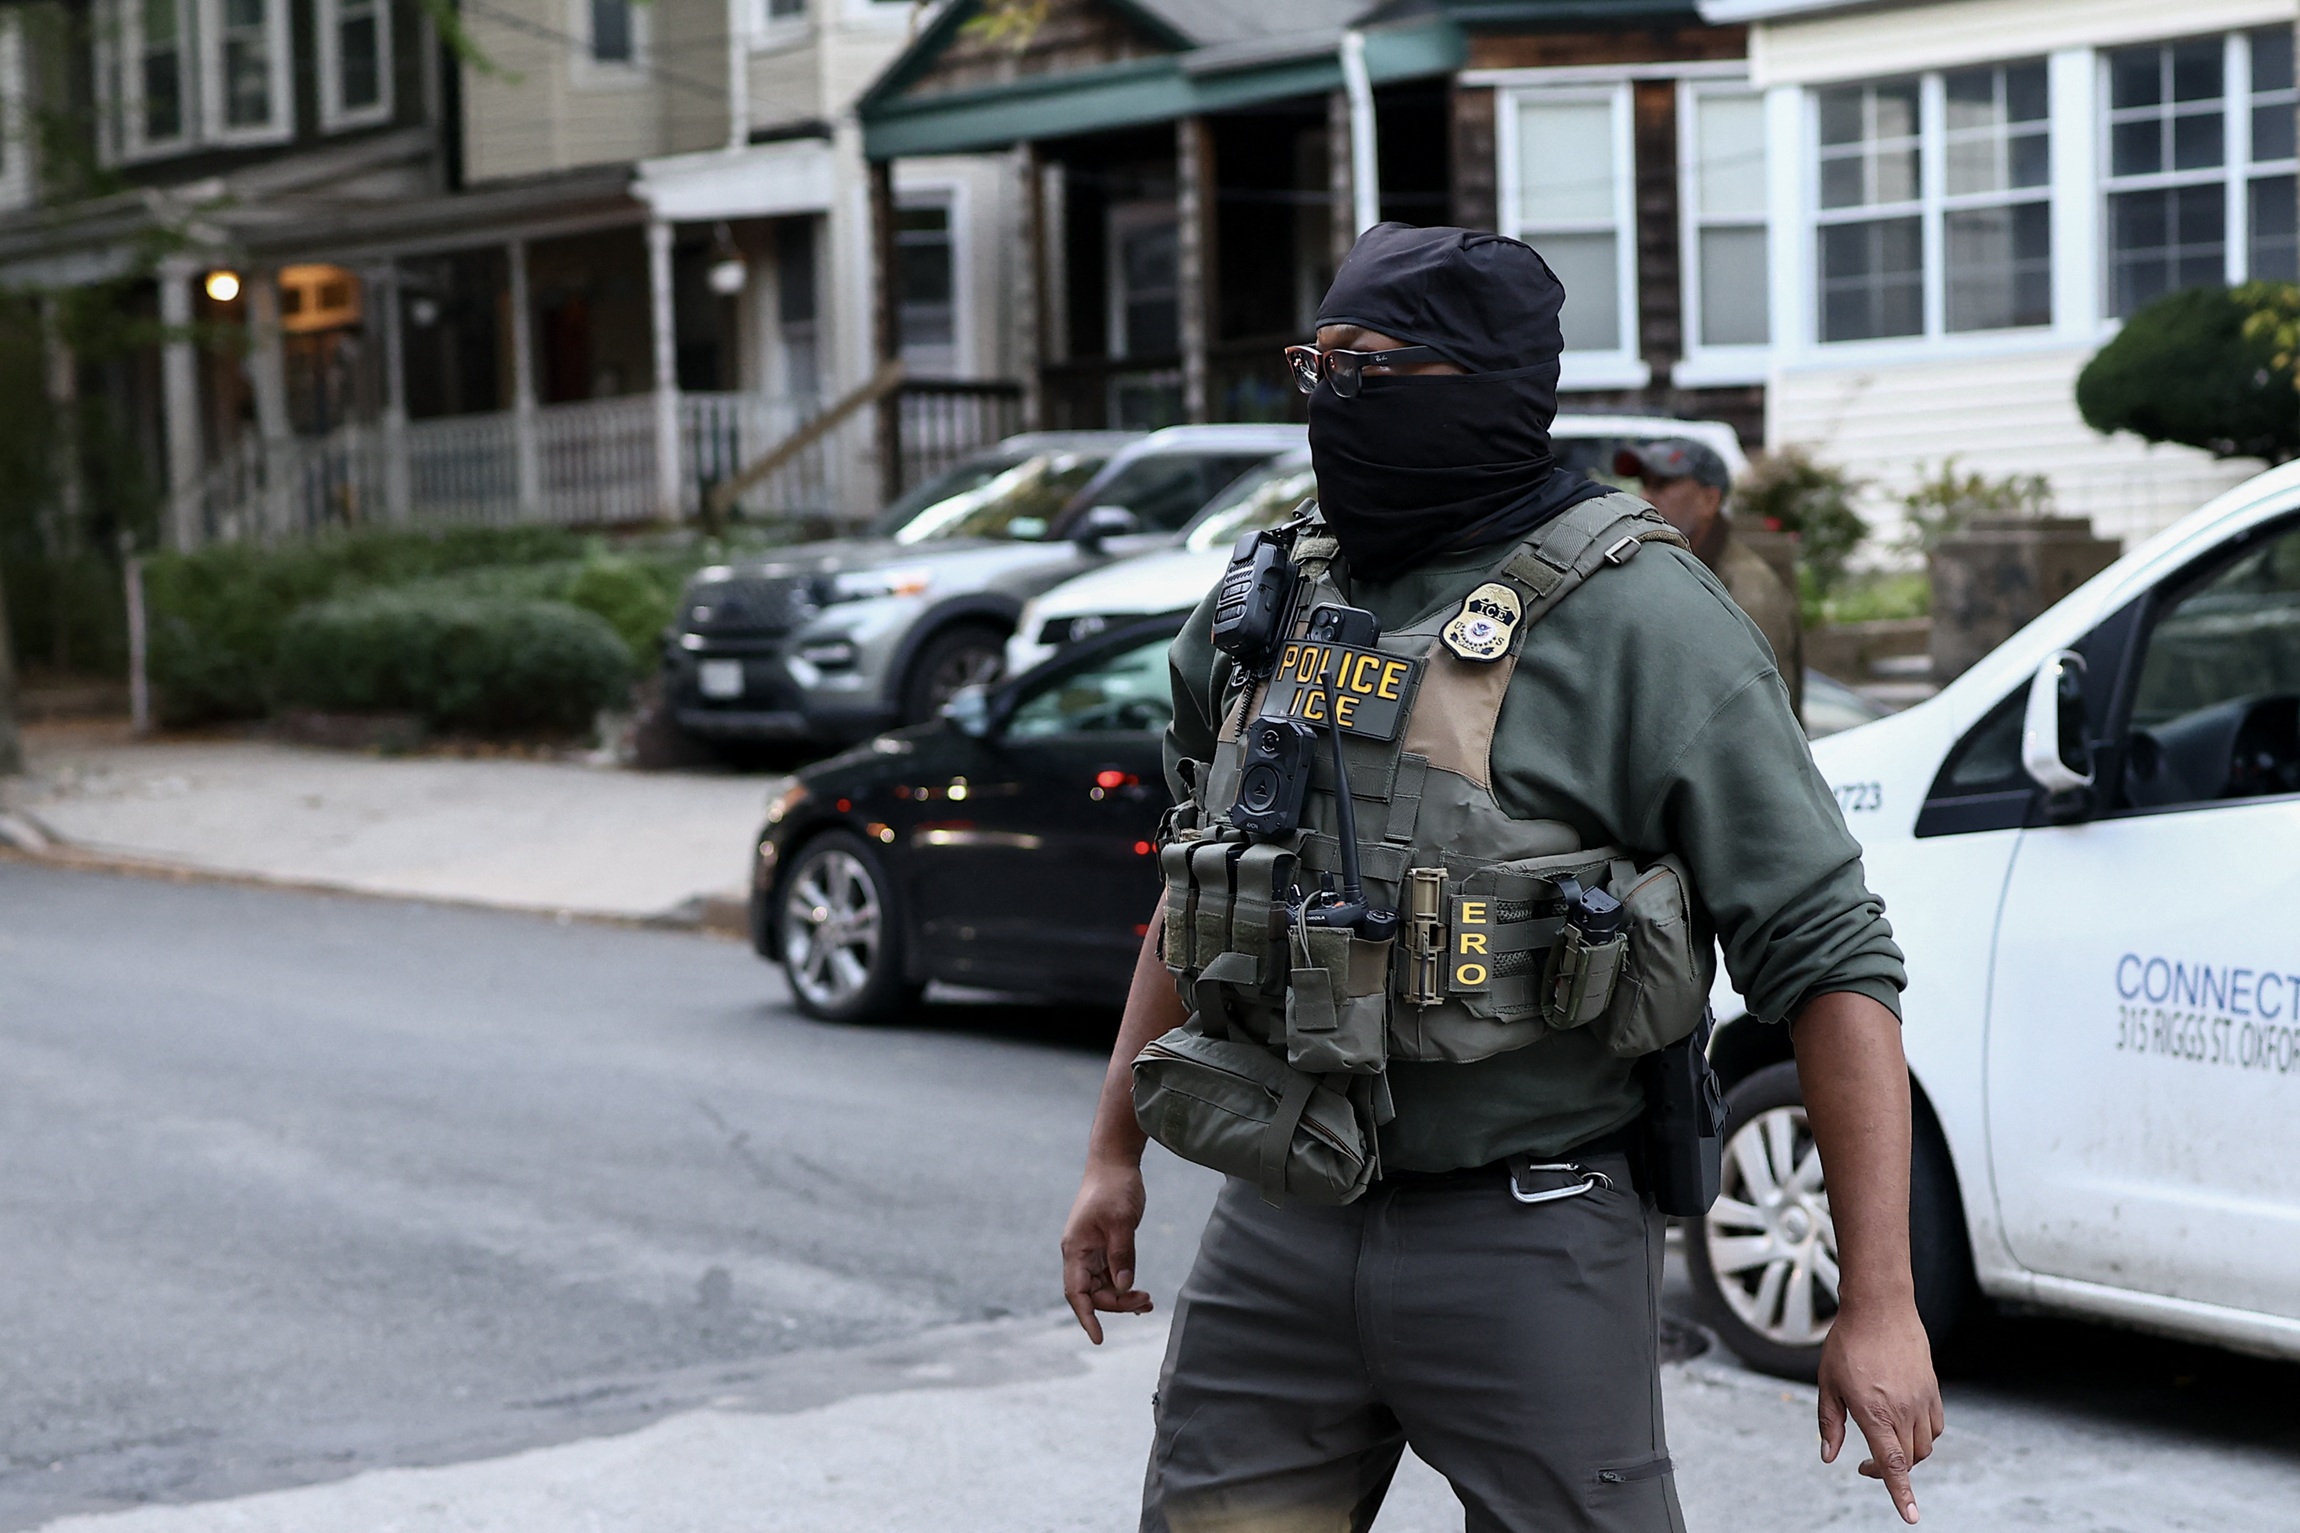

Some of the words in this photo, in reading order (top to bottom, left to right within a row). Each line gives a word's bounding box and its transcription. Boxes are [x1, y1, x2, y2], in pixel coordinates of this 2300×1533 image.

[1477, 603, 1507, 622] ICE
[1276, 645, 1408, 700] POLICE
[1288, 688, 1361, 727] ICE
[1456, 902, 1488, 985] ERO
[2116, 953, 2300, 1021] CONNECT
[2116, 1005, 2148, 1052] 315
[2152, 1008, 2206, 1063] RIGGS
